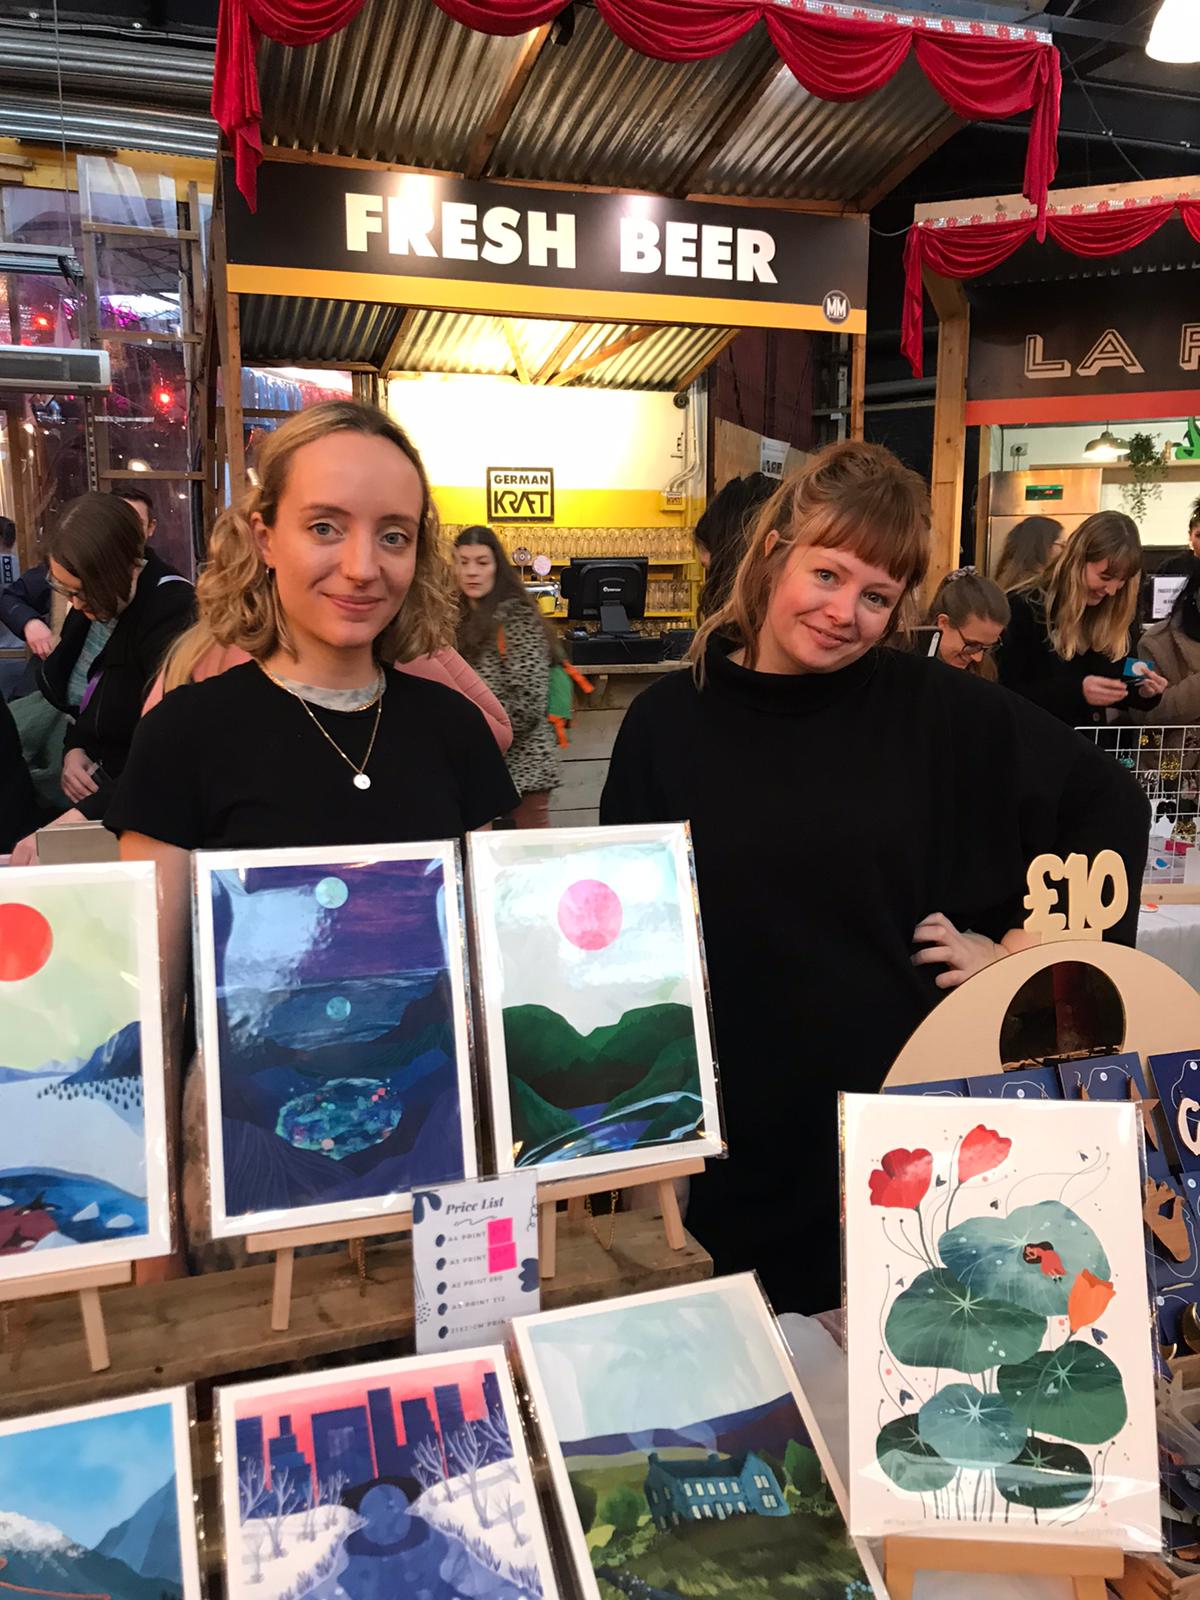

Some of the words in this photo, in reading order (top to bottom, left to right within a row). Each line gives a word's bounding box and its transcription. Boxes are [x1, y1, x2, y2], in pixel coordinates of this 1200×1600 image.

[345, 192, 576, 269] FRESH
[619, 217, 778, 284] BEER
[1024, 328, 1145, 379] LA
[494, 474, 549, 485] GERMAN
[494, 490, 549, 514] KRAFT
[1023, 849, 1128, 932] £10
[446, 1202, 478, 1215] Price
[482, 1197, 504, 1209] List
[461, 1231, 486, 1240] PRINT
[462, 1254, 487, 1263] PRINT
[463, 1278, 487, 1287] PRINT
[465, 1299, 489, 1307] PRINT
